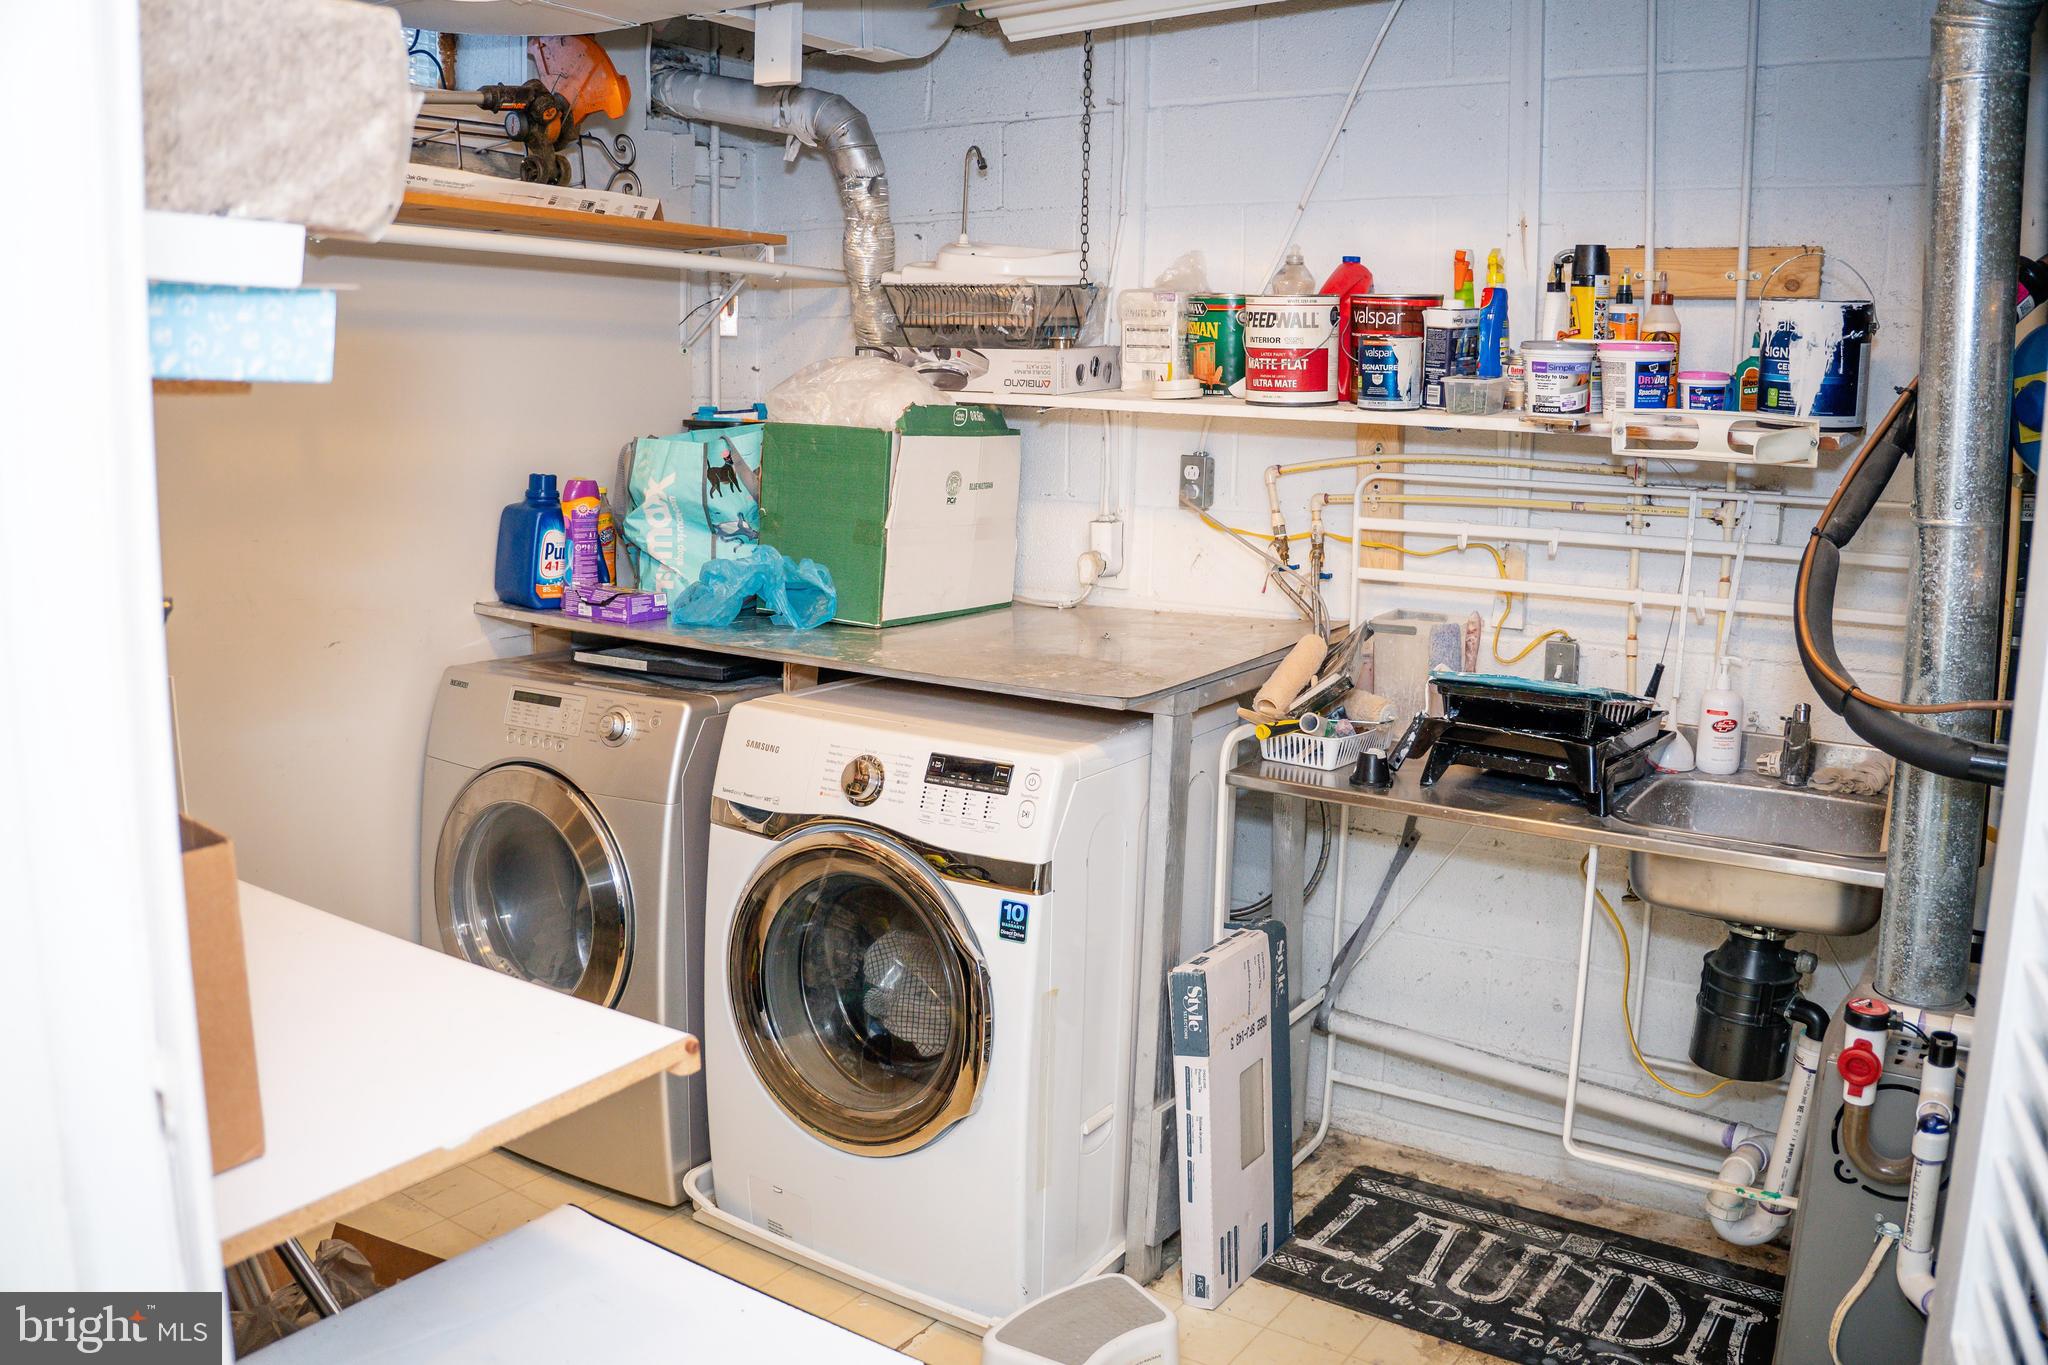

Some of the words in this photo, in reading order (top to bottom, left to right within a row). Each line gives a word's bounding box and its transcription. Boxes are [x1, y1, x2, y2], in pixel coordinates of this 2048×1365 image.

[1353, 306, 1403, 329] valspar
[1249, 336, 1281, 344] INTERIOR
[1365, 348, 1393, 360] valspar
[1248, 357, 1278, 371] MATTE
[1280, 358, 1309, 371] FLAT
[1361, 364, 1398, 372] SIGNATURE
[1253, 379, 1273, 388] ULTRA
[1274, 379, 1297, 388] MATE
[745, 739, 780, 754] SAMSUNG
[1003, 903, 1025, 922] 10
[1275, 939, 1287, 996] Style
[1183, 985, 1204, 1032] Style
